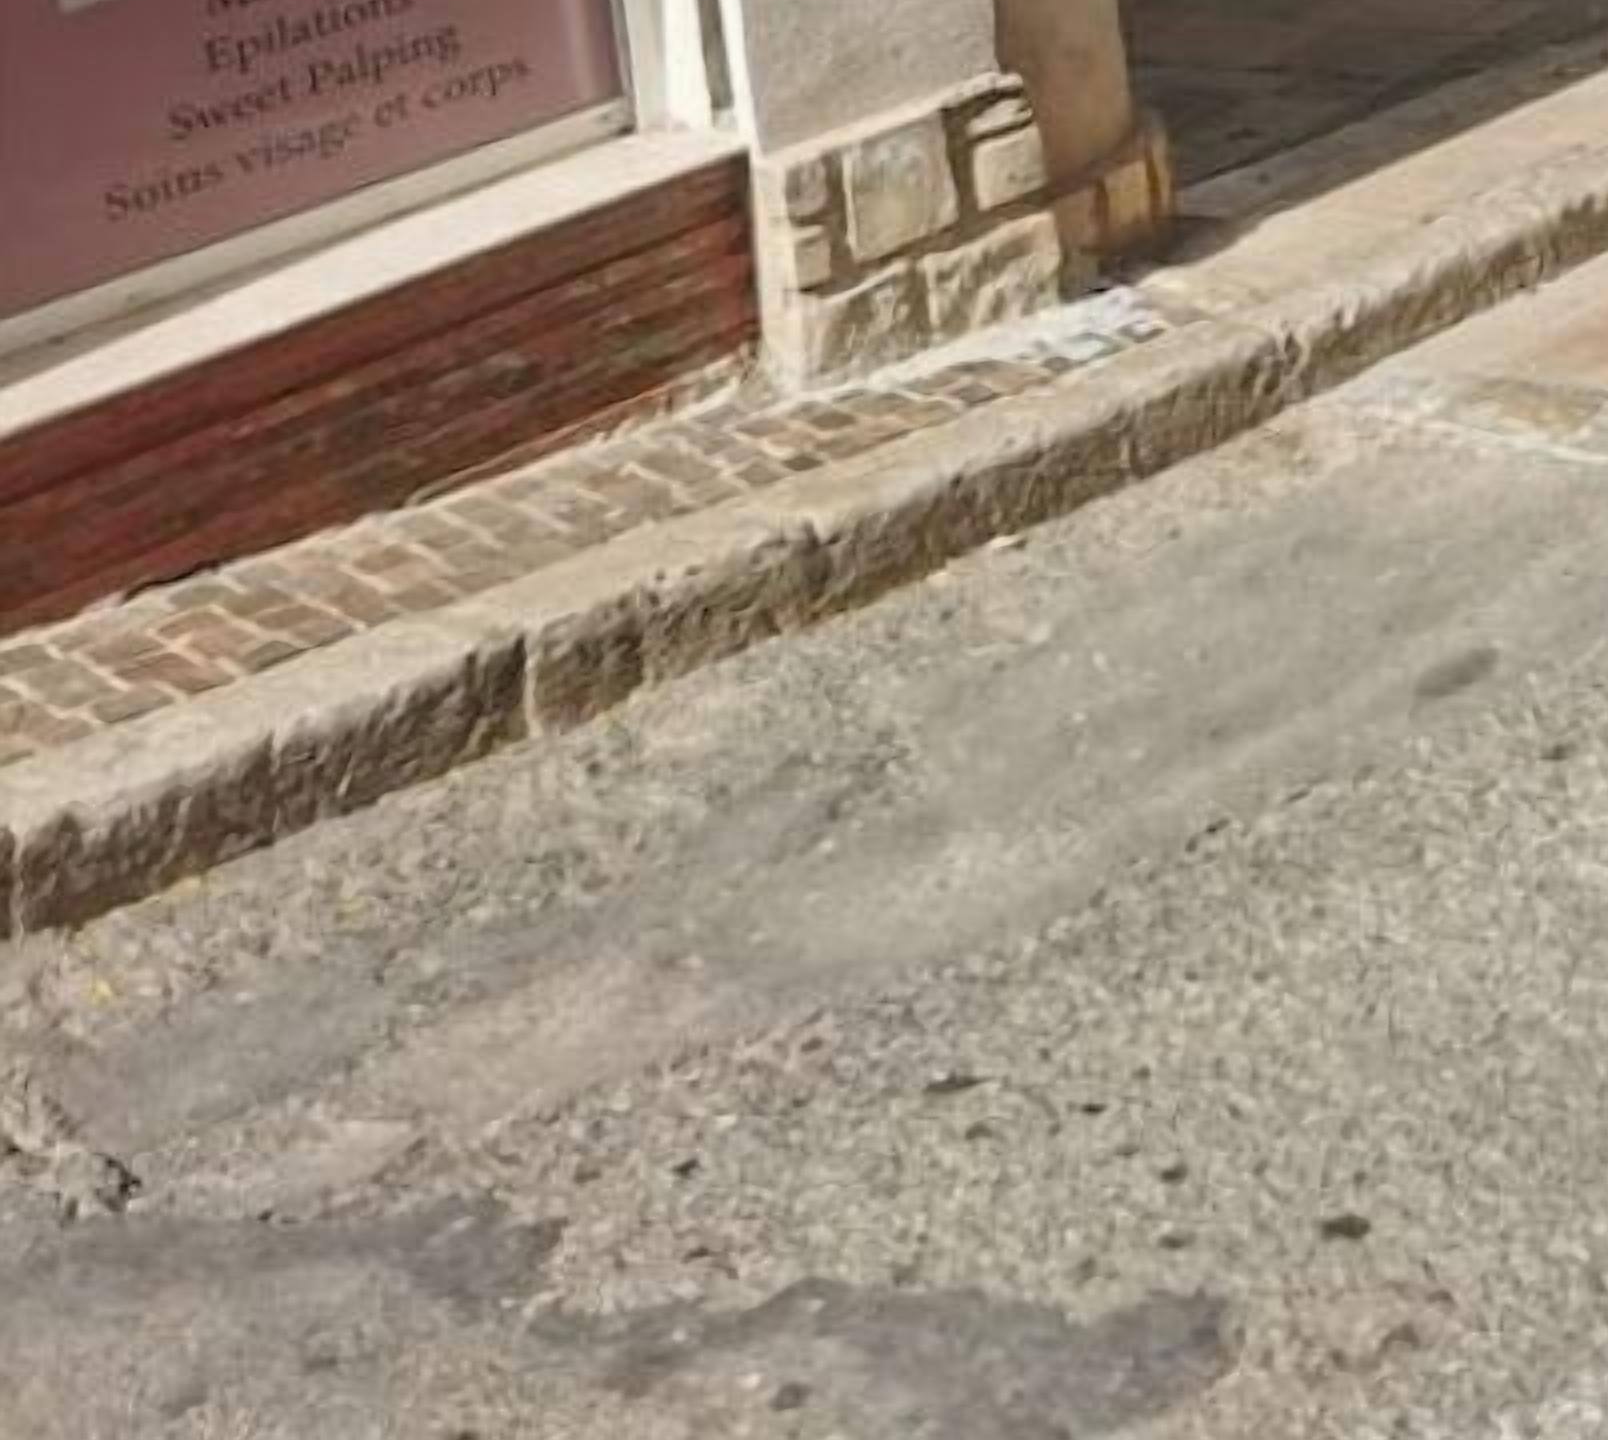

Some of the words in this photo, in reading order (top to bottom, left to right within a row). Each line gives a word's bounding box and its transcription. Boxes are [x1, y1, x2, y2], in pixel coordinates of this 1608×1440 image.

[104, 164, 225, 222] Soins
[235, 111, 362, 175] visage
[374, 93, 410, 129] et
[422, 53, 533, 111] corps
[167, 81, 293, 142] Sweet
[308, 24, 461, 95] Palping
